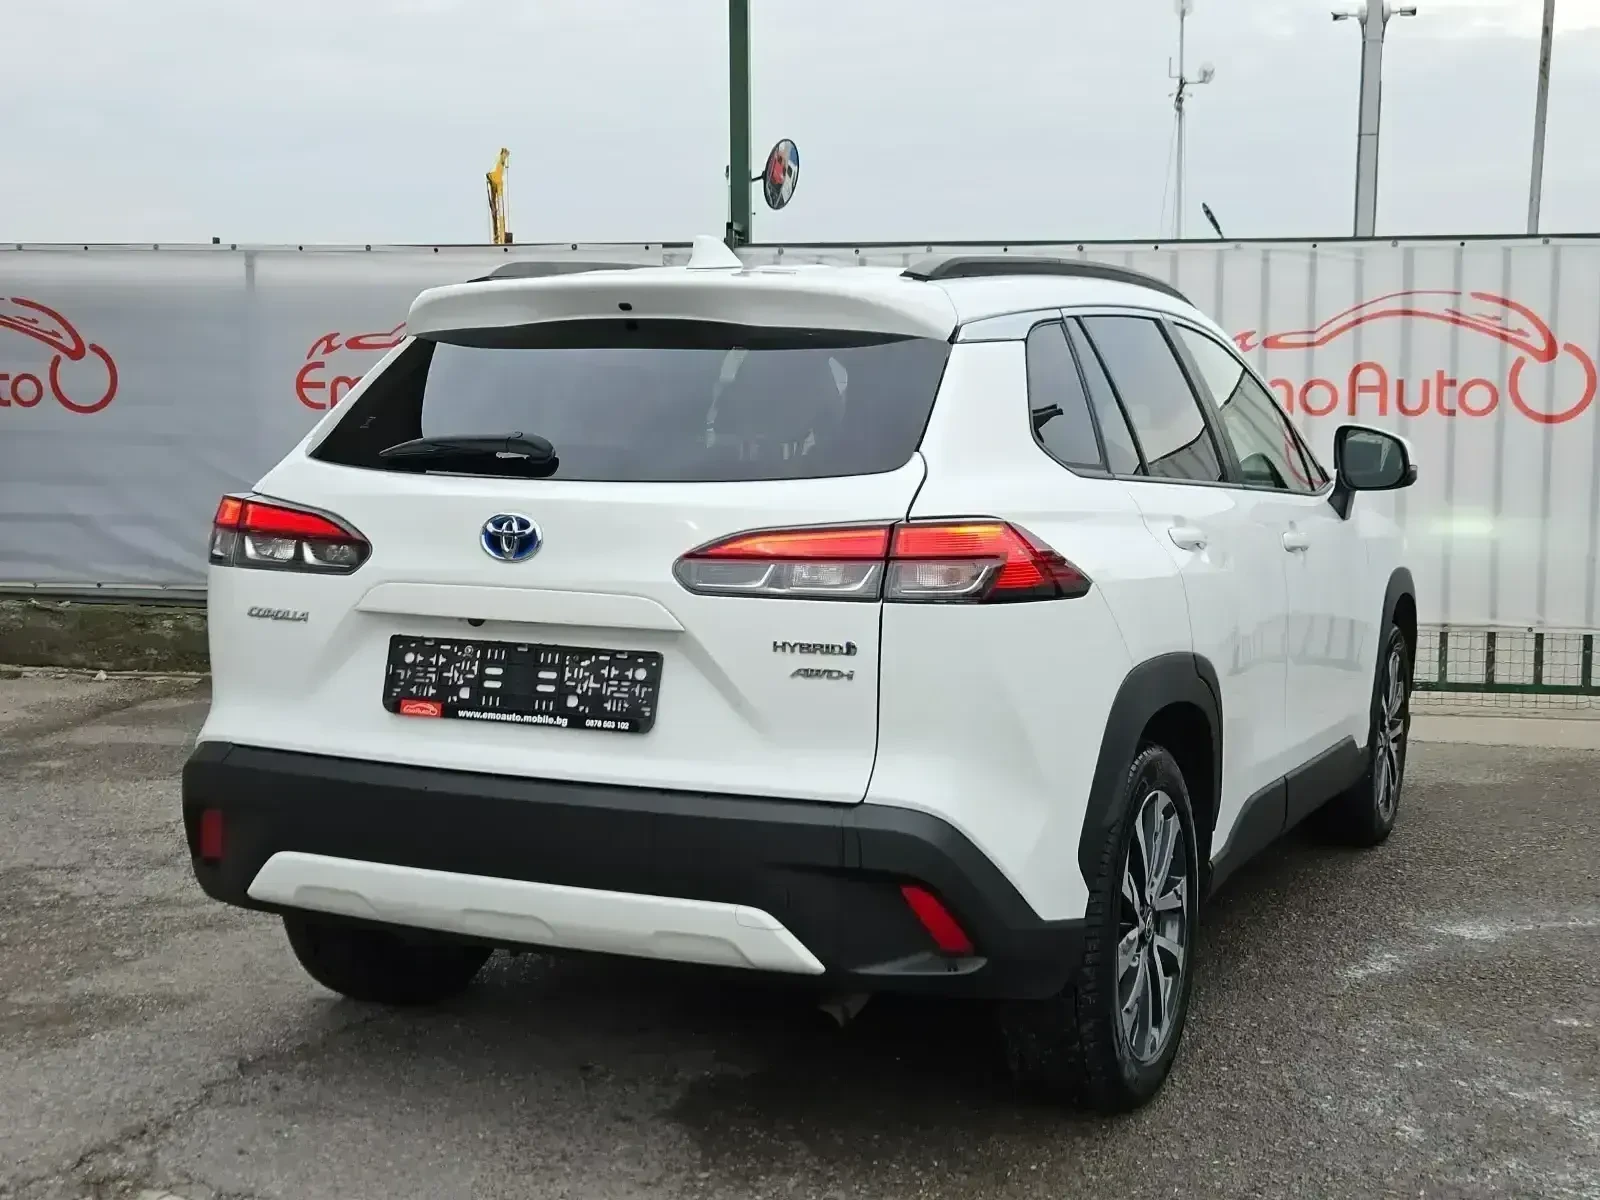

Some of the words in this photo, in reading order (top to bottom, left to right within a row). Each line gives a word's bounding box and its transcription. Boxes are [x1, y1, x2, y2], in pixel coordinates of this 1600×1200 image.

[247, 606, 309, 623] COROLLA
[773, 641, 845, 655] HYBRID
[790, 668, 855, 681] AWD-i
[458, 710, 568, 727] www.emoauto.mobile.bg
[617, 721, 630, 730] 102
